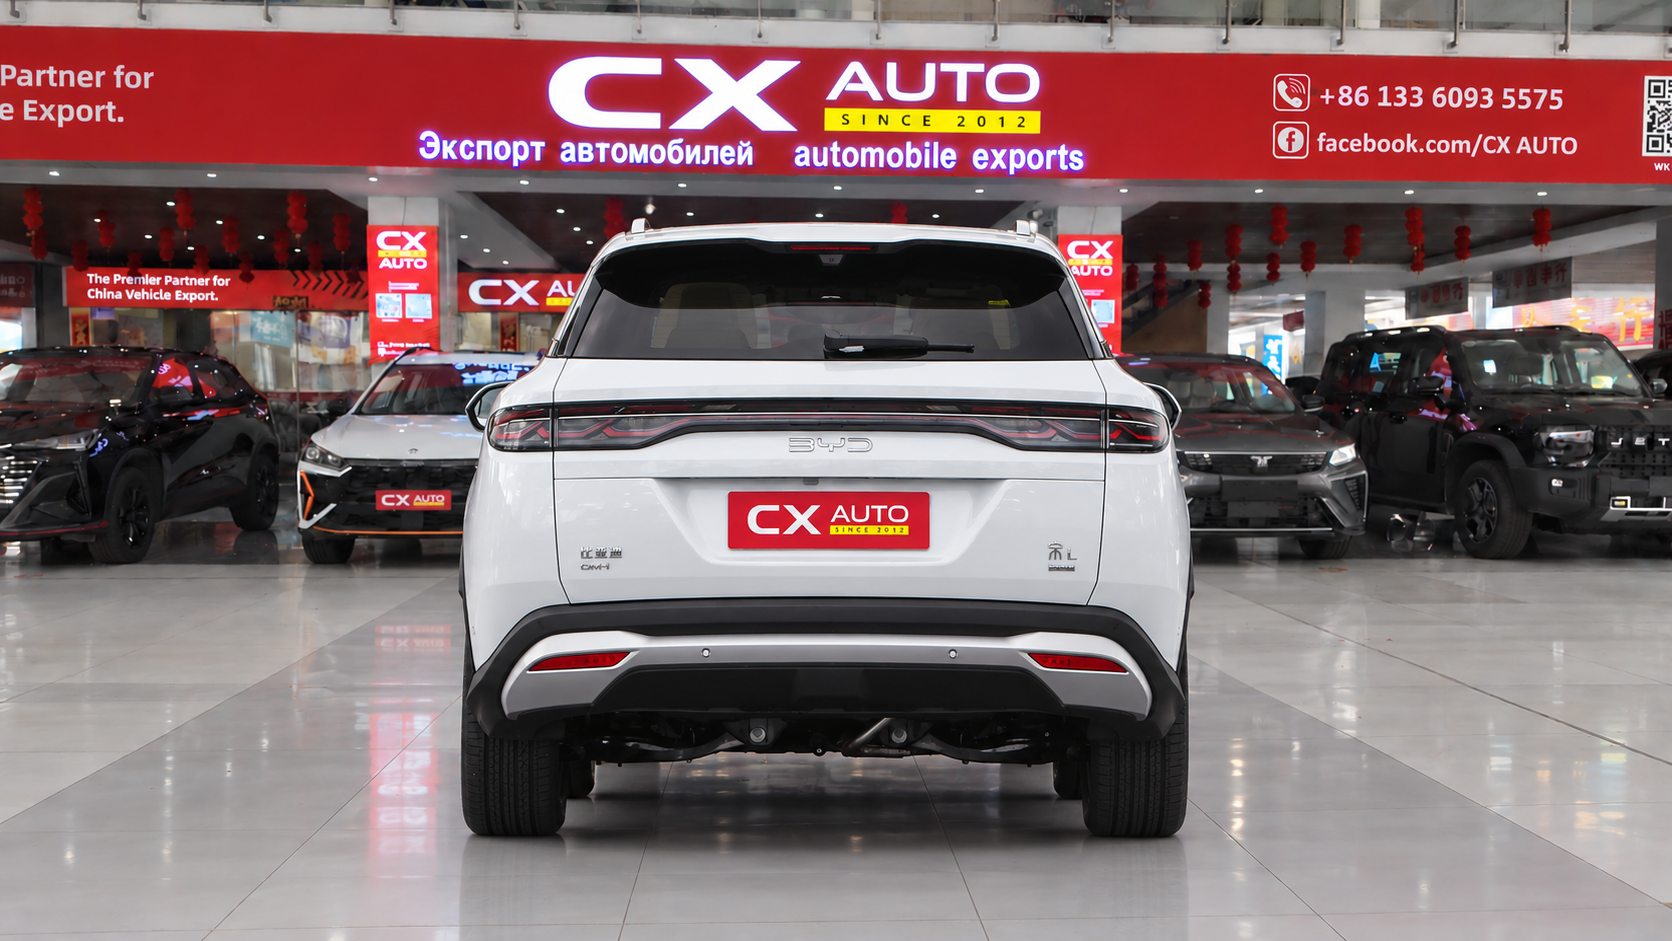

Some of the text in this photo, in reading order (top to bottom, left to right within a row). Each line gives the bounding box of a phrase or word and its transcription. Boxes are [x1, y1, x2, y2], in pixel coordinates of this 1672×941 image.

[0, 64, 154, 89] Partner for
[547, 55, 1041, 132] CX AUTO
[1320, 85, 1563, 110] +86 133 6093 5575
[0, 99, 124, 128] e Export.
[841, 113, 1026, 129] SINCE 2012
[418, 130, 754, 167] Экспорт автомобилей
[1317, 132, 1578, 158] facebook.com/CX AUTO
[794, 140, 1085, 175] automobile exports
[376, 230, 427, 251] CX
[1067, 240, 1114, 260] CX
[378, 257, 428, 269] AUTO
[1070, 265, 1113, 276] AUTO
[87, 273, 231, 286] The Premier Partner for
[86, 288, 218, 303] China Vehicle Export.
[468, 279, 540, 306] CX
[788, 437, 873, 452] BYD
[381, 494, 445, 506] CX AUTO
[747, 504, 909, 535] CX AUTO
